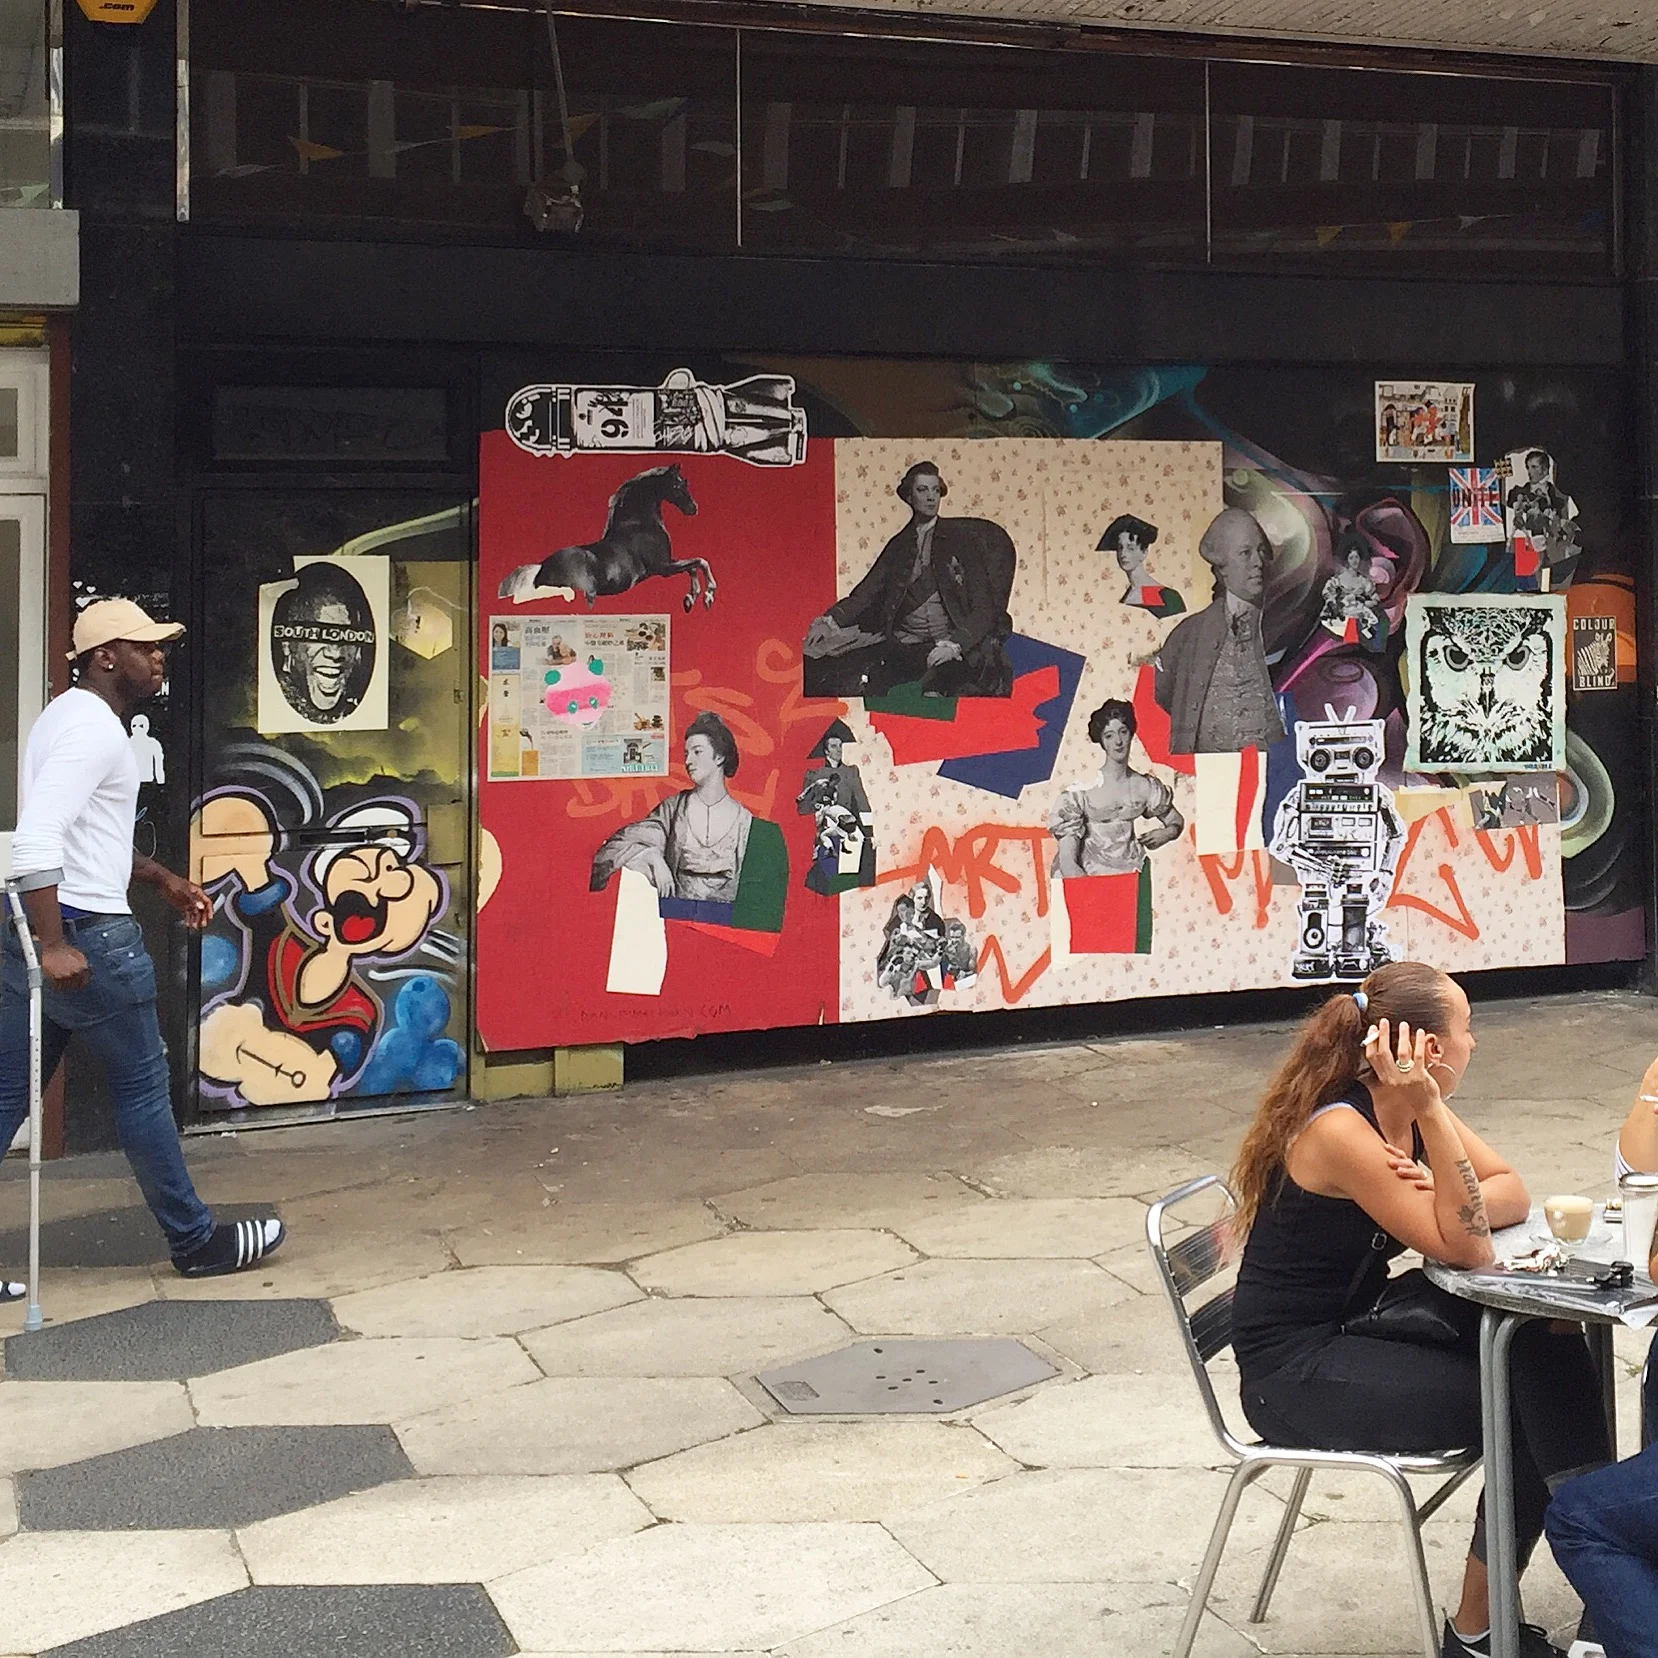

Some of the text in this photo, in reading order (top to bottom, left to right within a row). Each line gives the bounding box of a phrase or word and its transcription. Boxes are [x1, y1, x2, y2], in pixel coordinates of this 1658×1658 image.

[99, 3, 135, 11] .com
[1573, 618, 1615, 630] COLOUR
[274, 625, 374, 643] SOUTH LONDON
[1580, 676, 1612, 687] BLIND
